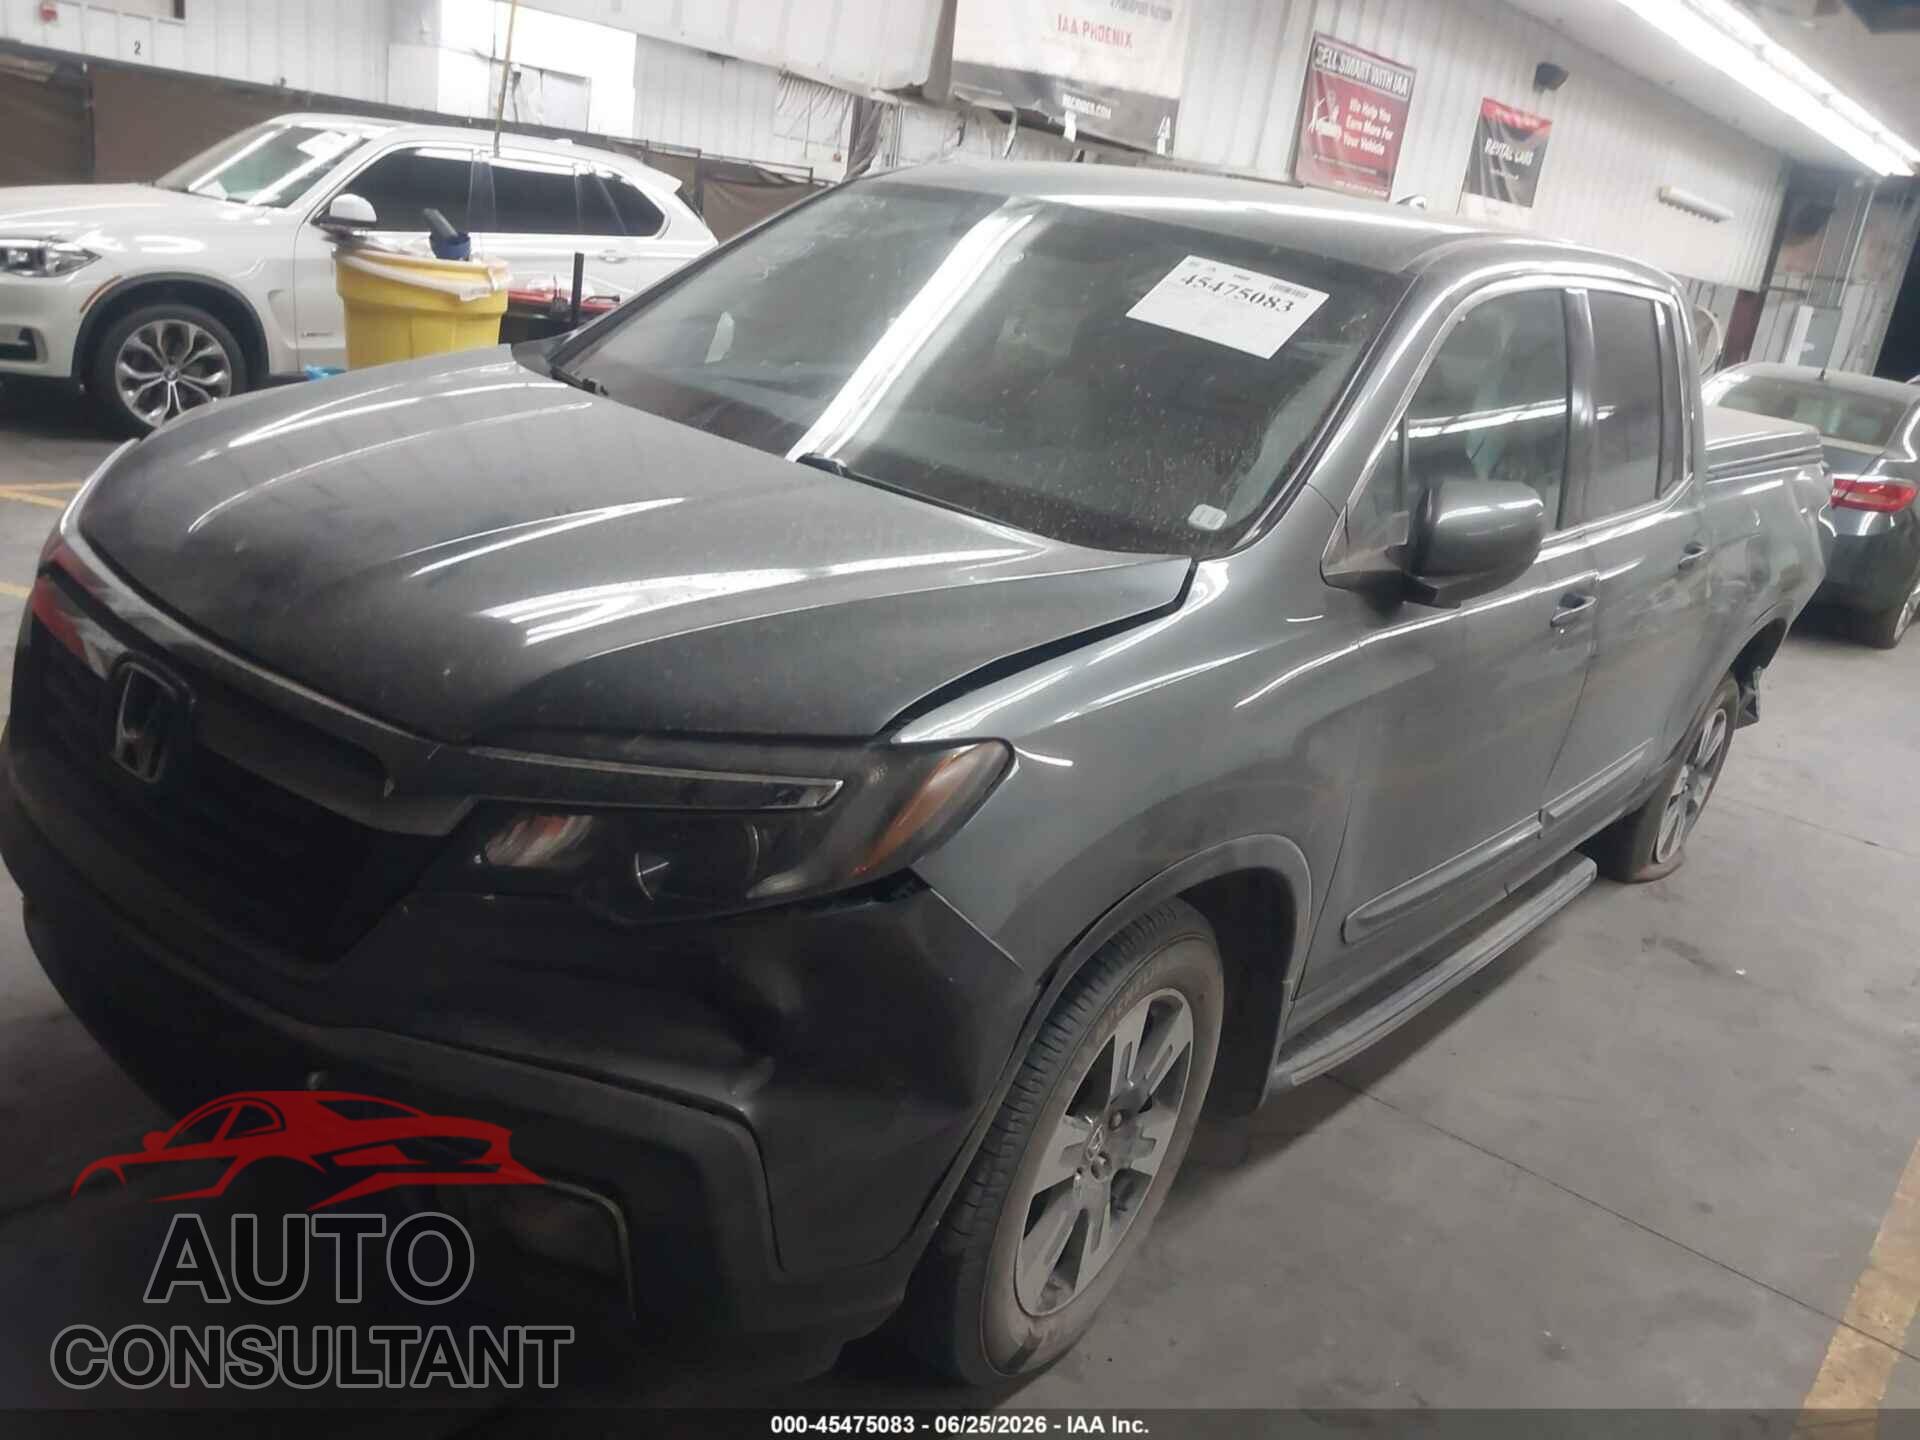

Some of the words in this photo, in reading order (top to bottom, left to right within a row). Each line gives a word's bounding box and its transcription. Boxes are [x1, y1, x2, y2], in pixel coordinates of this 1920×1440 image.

[134, 40, 142, 56] 2
[1082, 19, 1134, 49] PHOENIX
[1313, 45, 1338, 72] SELL
[1339, 53, 1371, 83] SMART
[1181, 273, 1296, 314] 45475083
